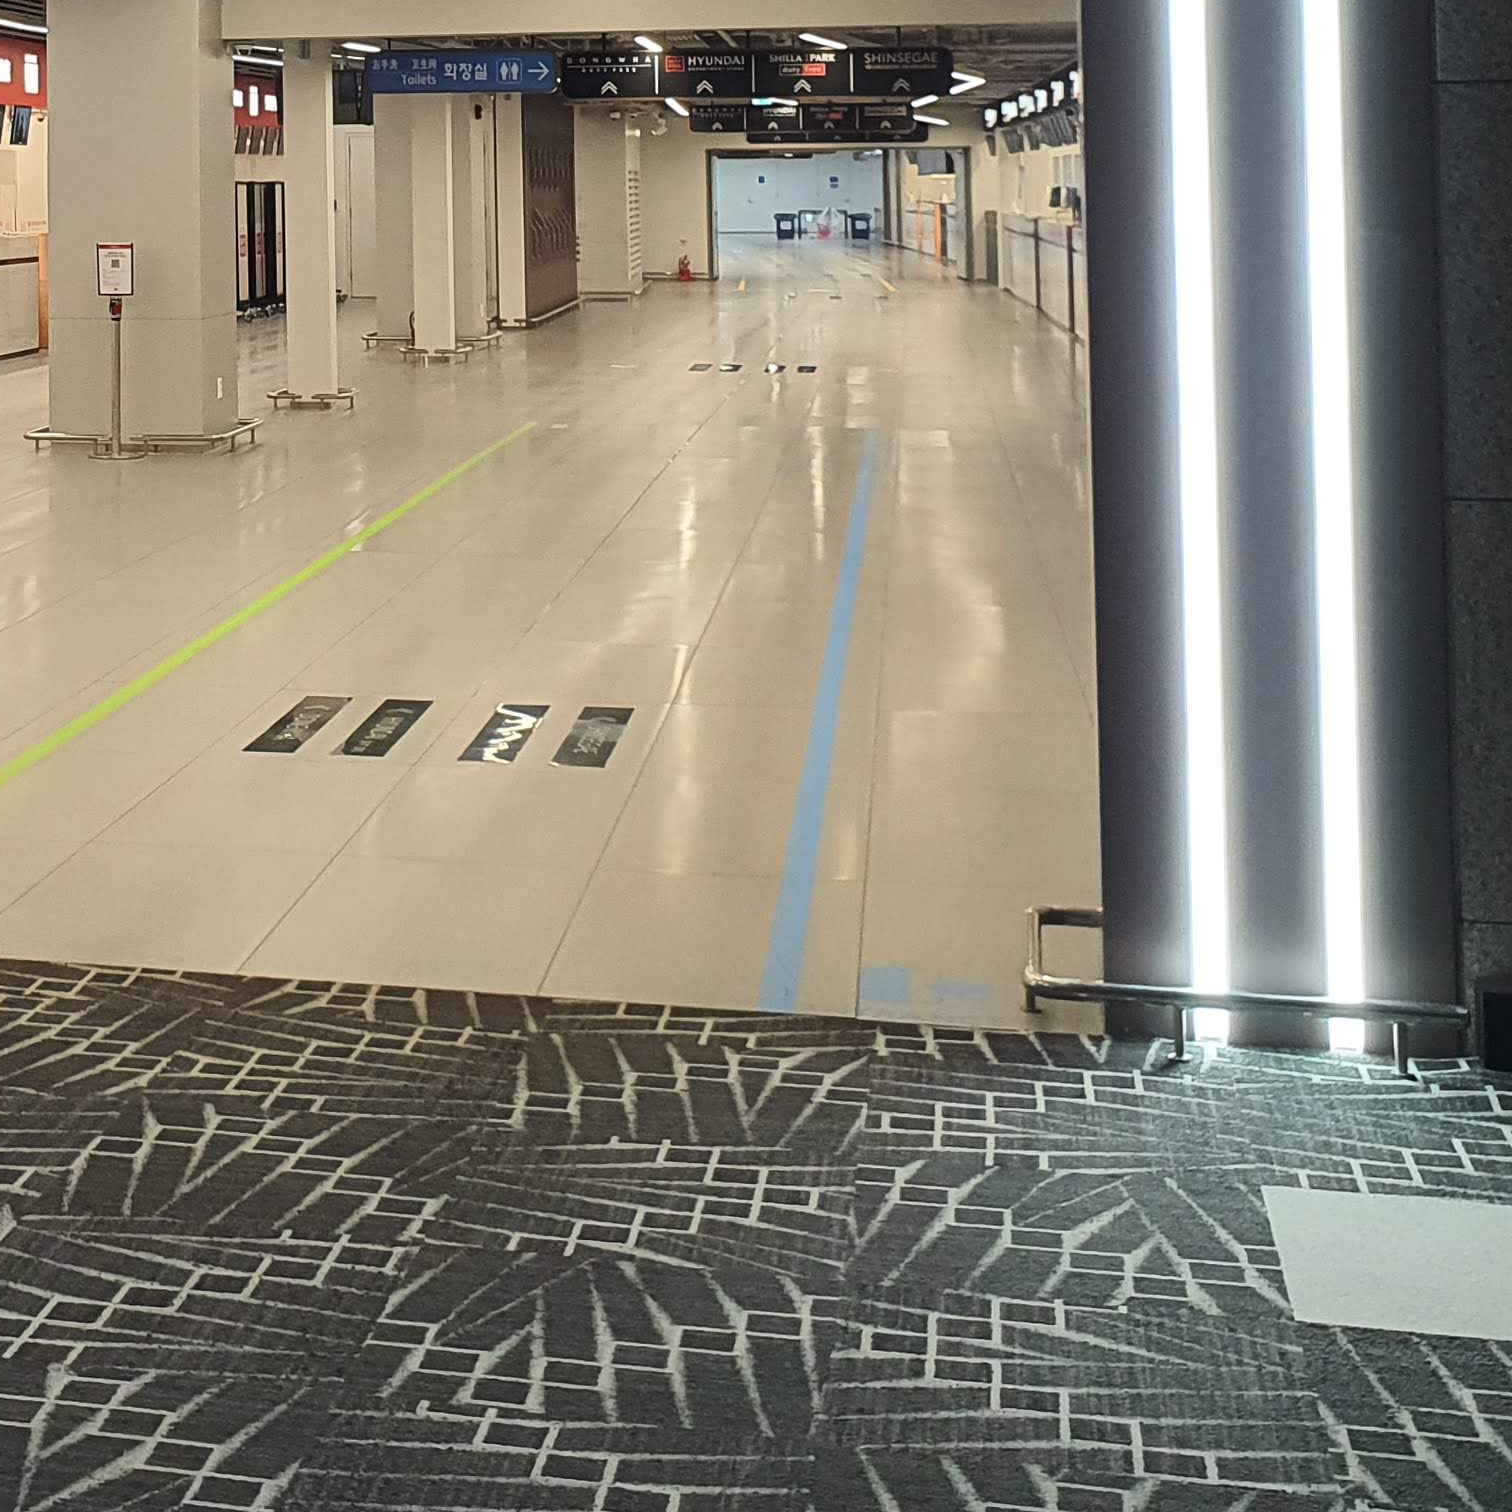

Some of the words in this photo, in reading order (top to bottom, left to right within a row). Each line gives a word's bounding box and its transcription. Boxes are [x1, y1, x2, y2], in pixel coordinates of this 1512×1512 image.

[567, 55, 653, 65] DONGWHA
[688, 55, 745, 66] HYUNDAI
[769, 53, 803, 63] SHILLA
[863, 52, 938, 64] SHINSEGAE
[400, 73, 437, 86] Toilets
